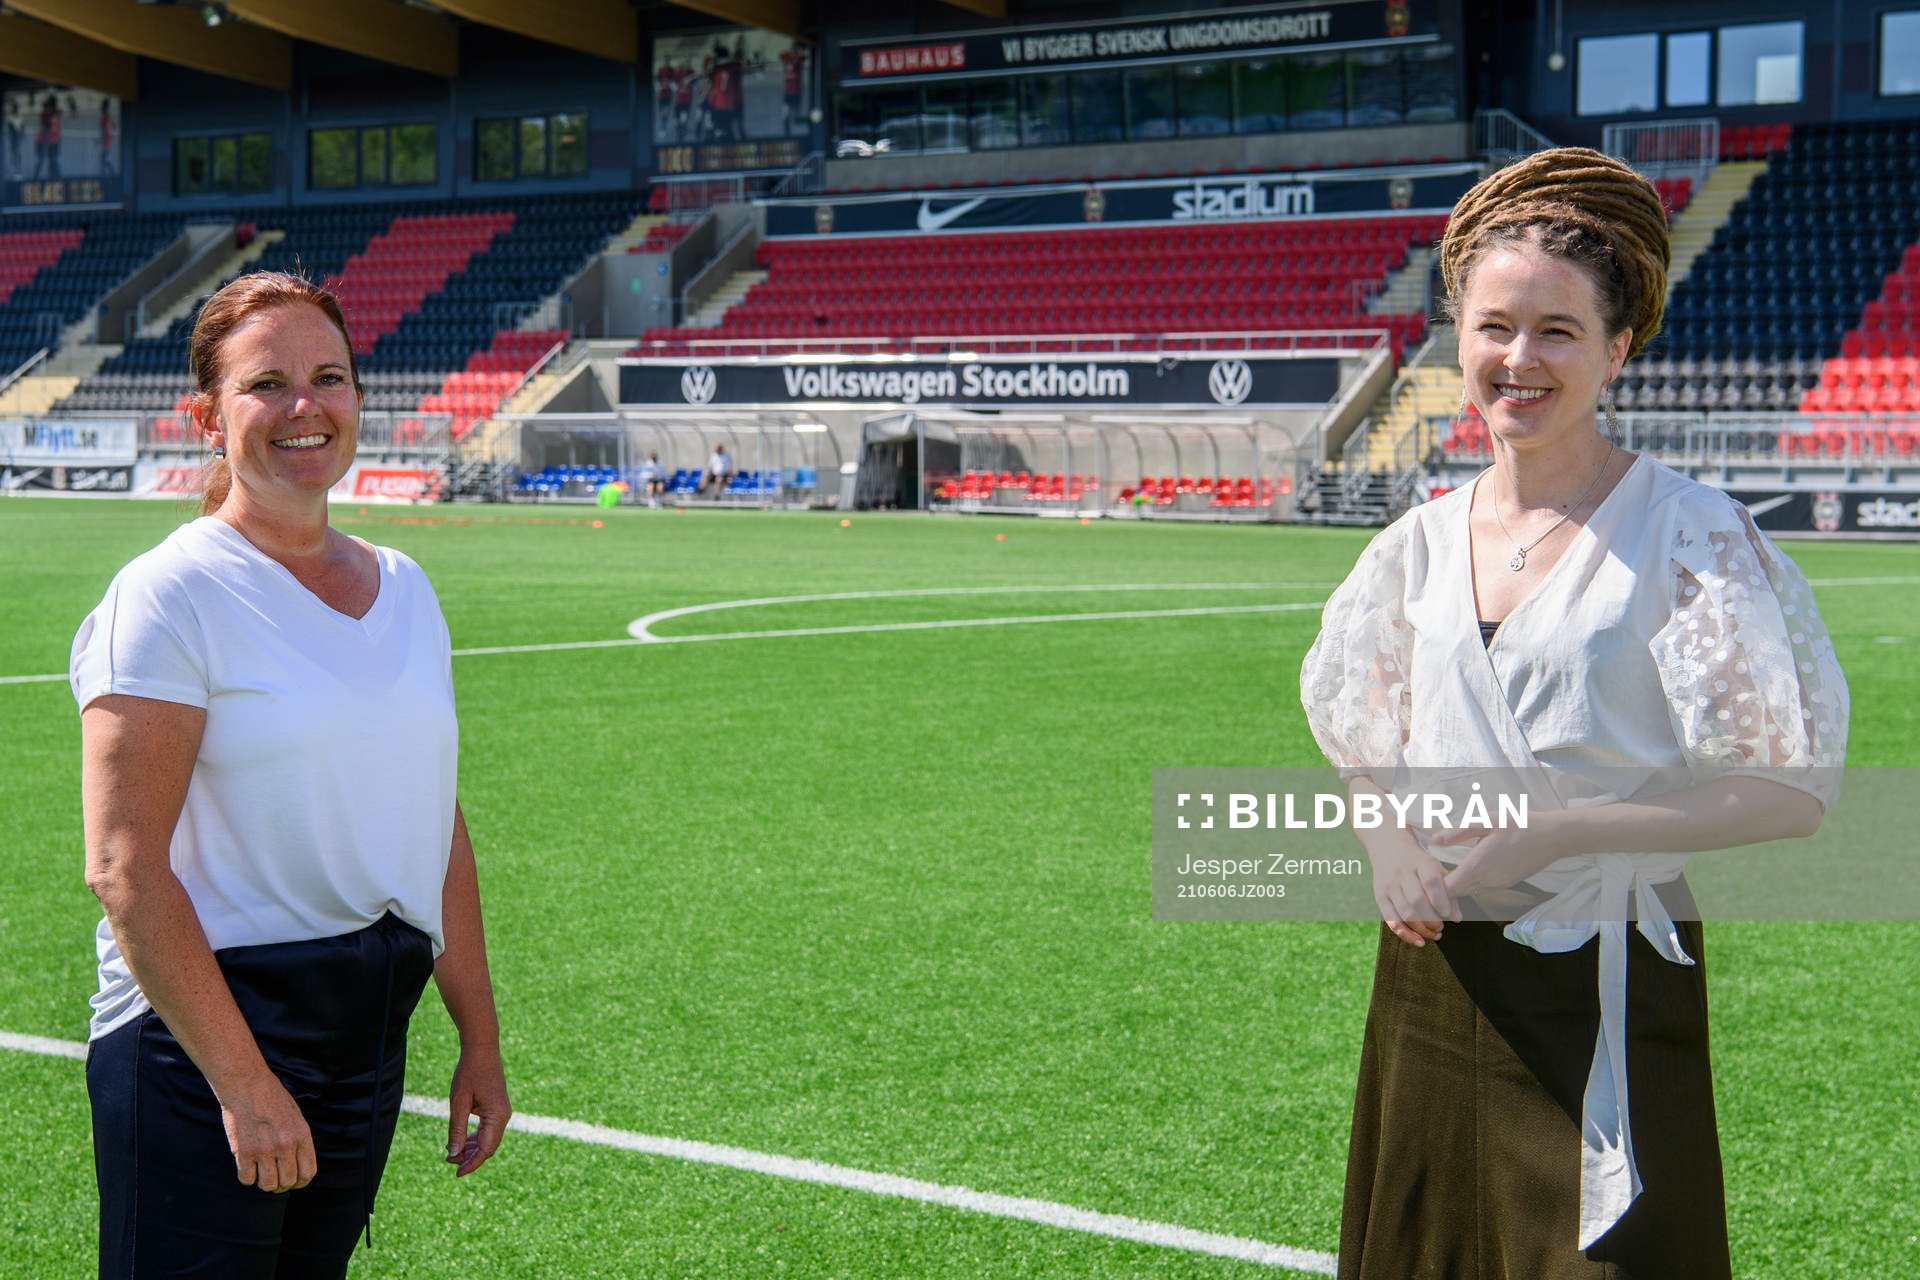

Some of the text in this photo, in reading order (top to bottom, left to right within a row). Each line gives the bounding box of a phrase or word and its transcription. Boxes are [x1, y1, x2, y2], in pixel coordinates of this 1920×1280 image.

[1002, 12, 1331, 62] VI BYGGER SVENSK UNGDOMSIDROTT
[861, 45, 965, 72] BAUHAUS
[1172, 181, 1315, 219] stadium
[783, 363, 1129, 403] Volkswagen Stockholm
